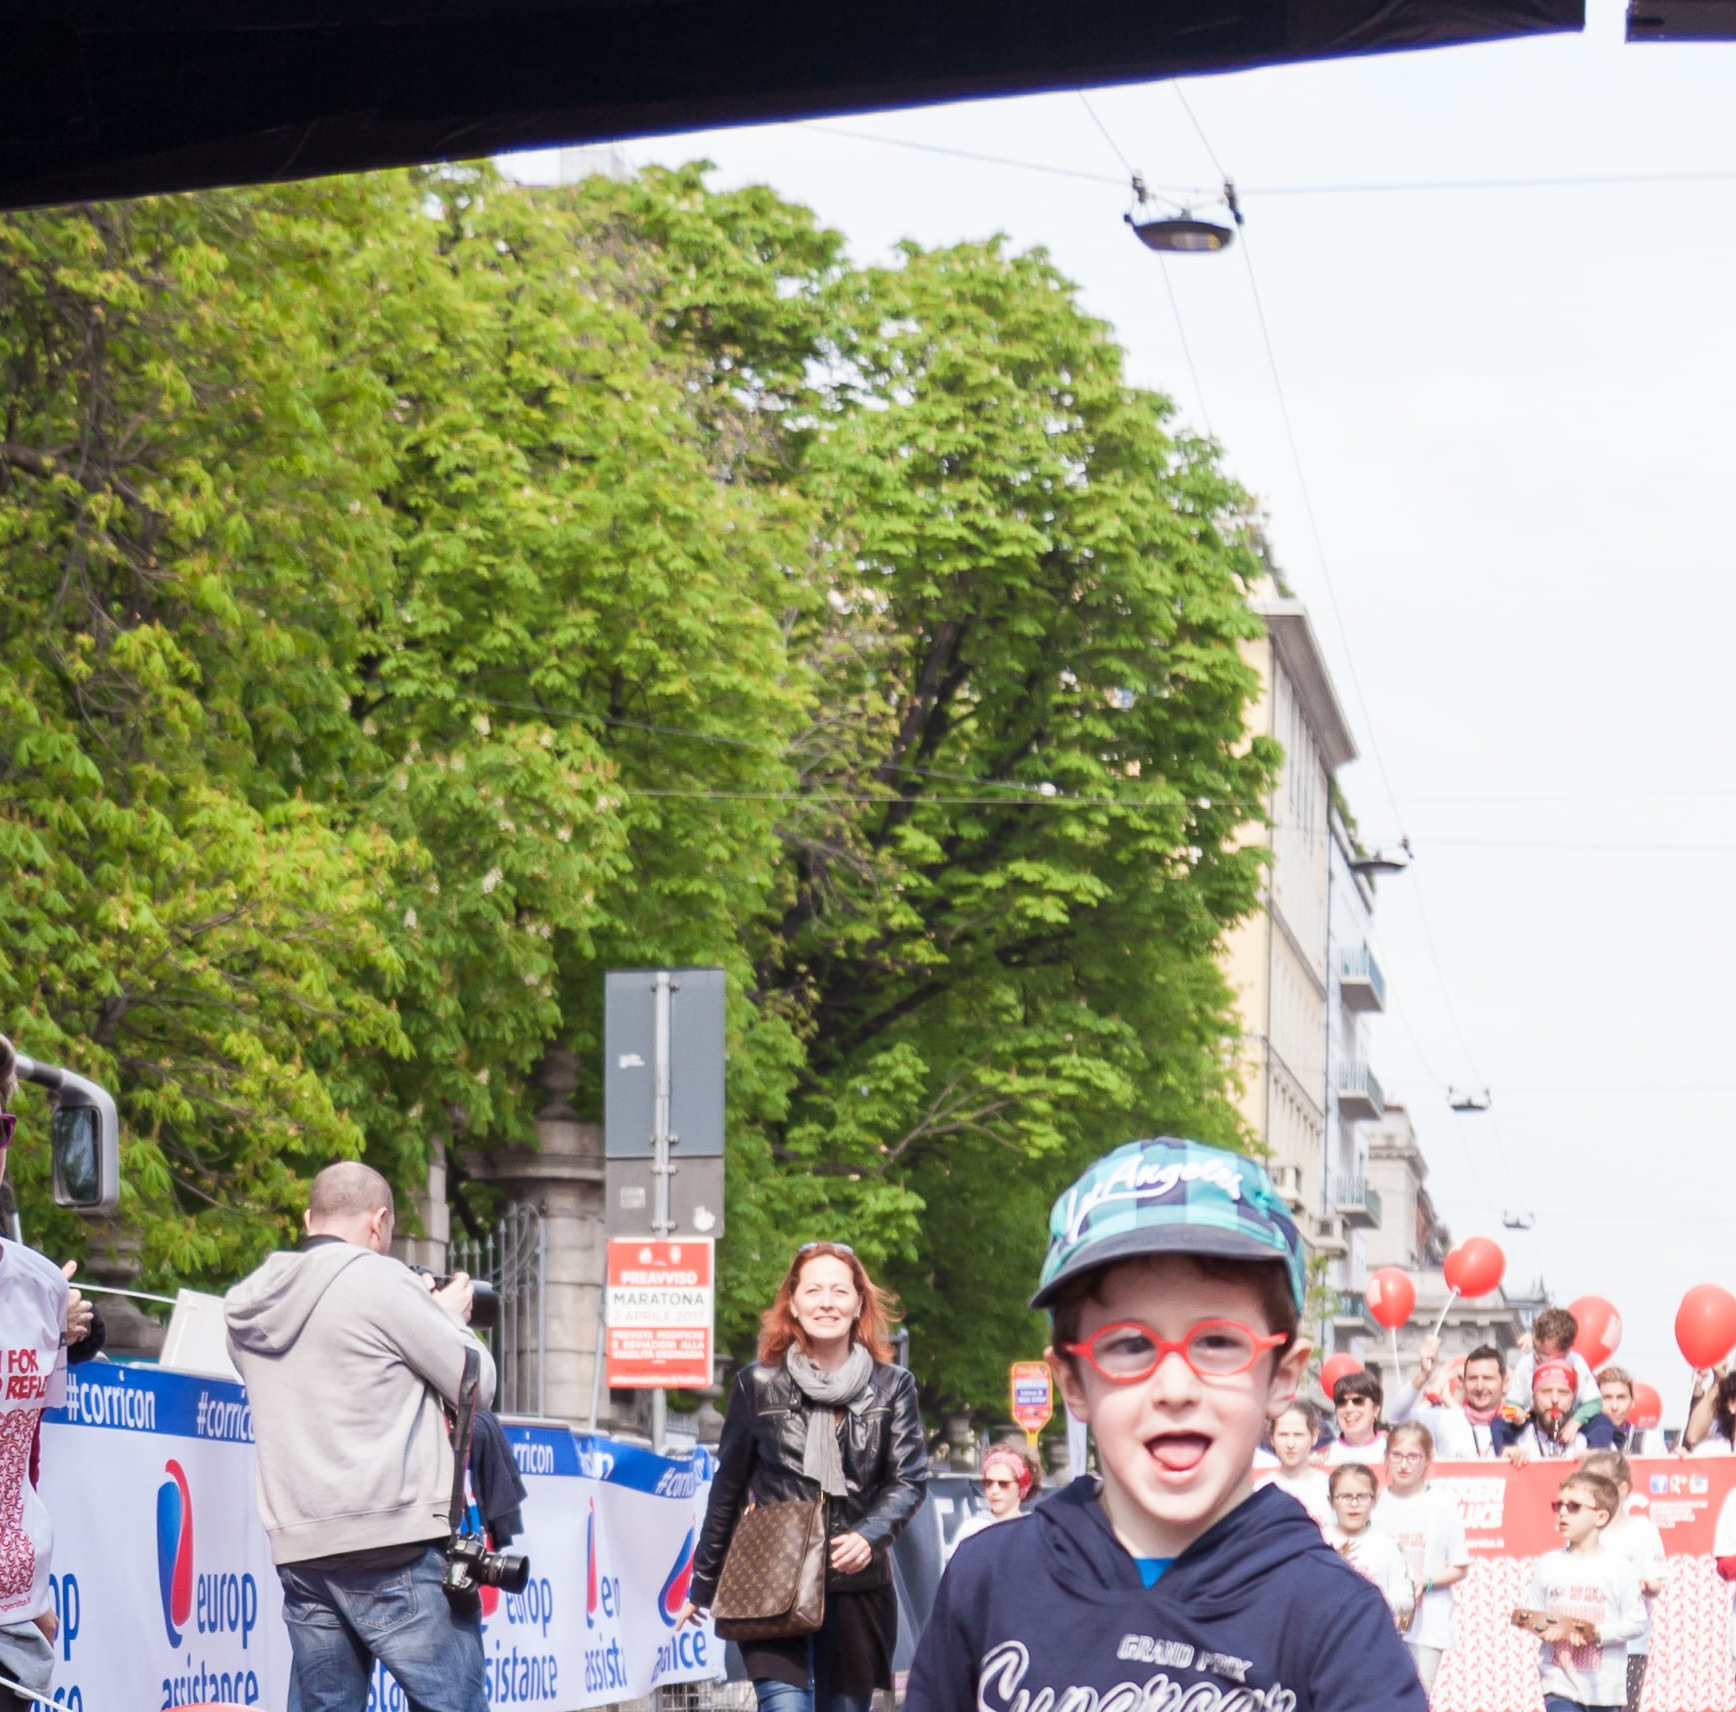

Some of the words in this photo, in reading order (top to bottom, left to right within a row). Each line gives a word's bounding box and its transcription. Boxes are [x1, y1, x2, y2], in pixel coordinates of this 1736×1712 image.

[613, 1292, 704, 1306] MARATONA
[620, 1271, 699, 1286] PREAVVISO
[8, 1348, 39, 1374] FOR
[66, 1370, 156, 1430] #corricon
[196, 1391, 255, 1442] #corric
[513, 1431, 554, 1475] rricon
[197, 1572, 258, 1650] europ
[484, 1640, 558, 1704] sistance
[1117, 1634, 1195, 1670] GRAND
[1195, 1650, 1254, 1683] PRIX
